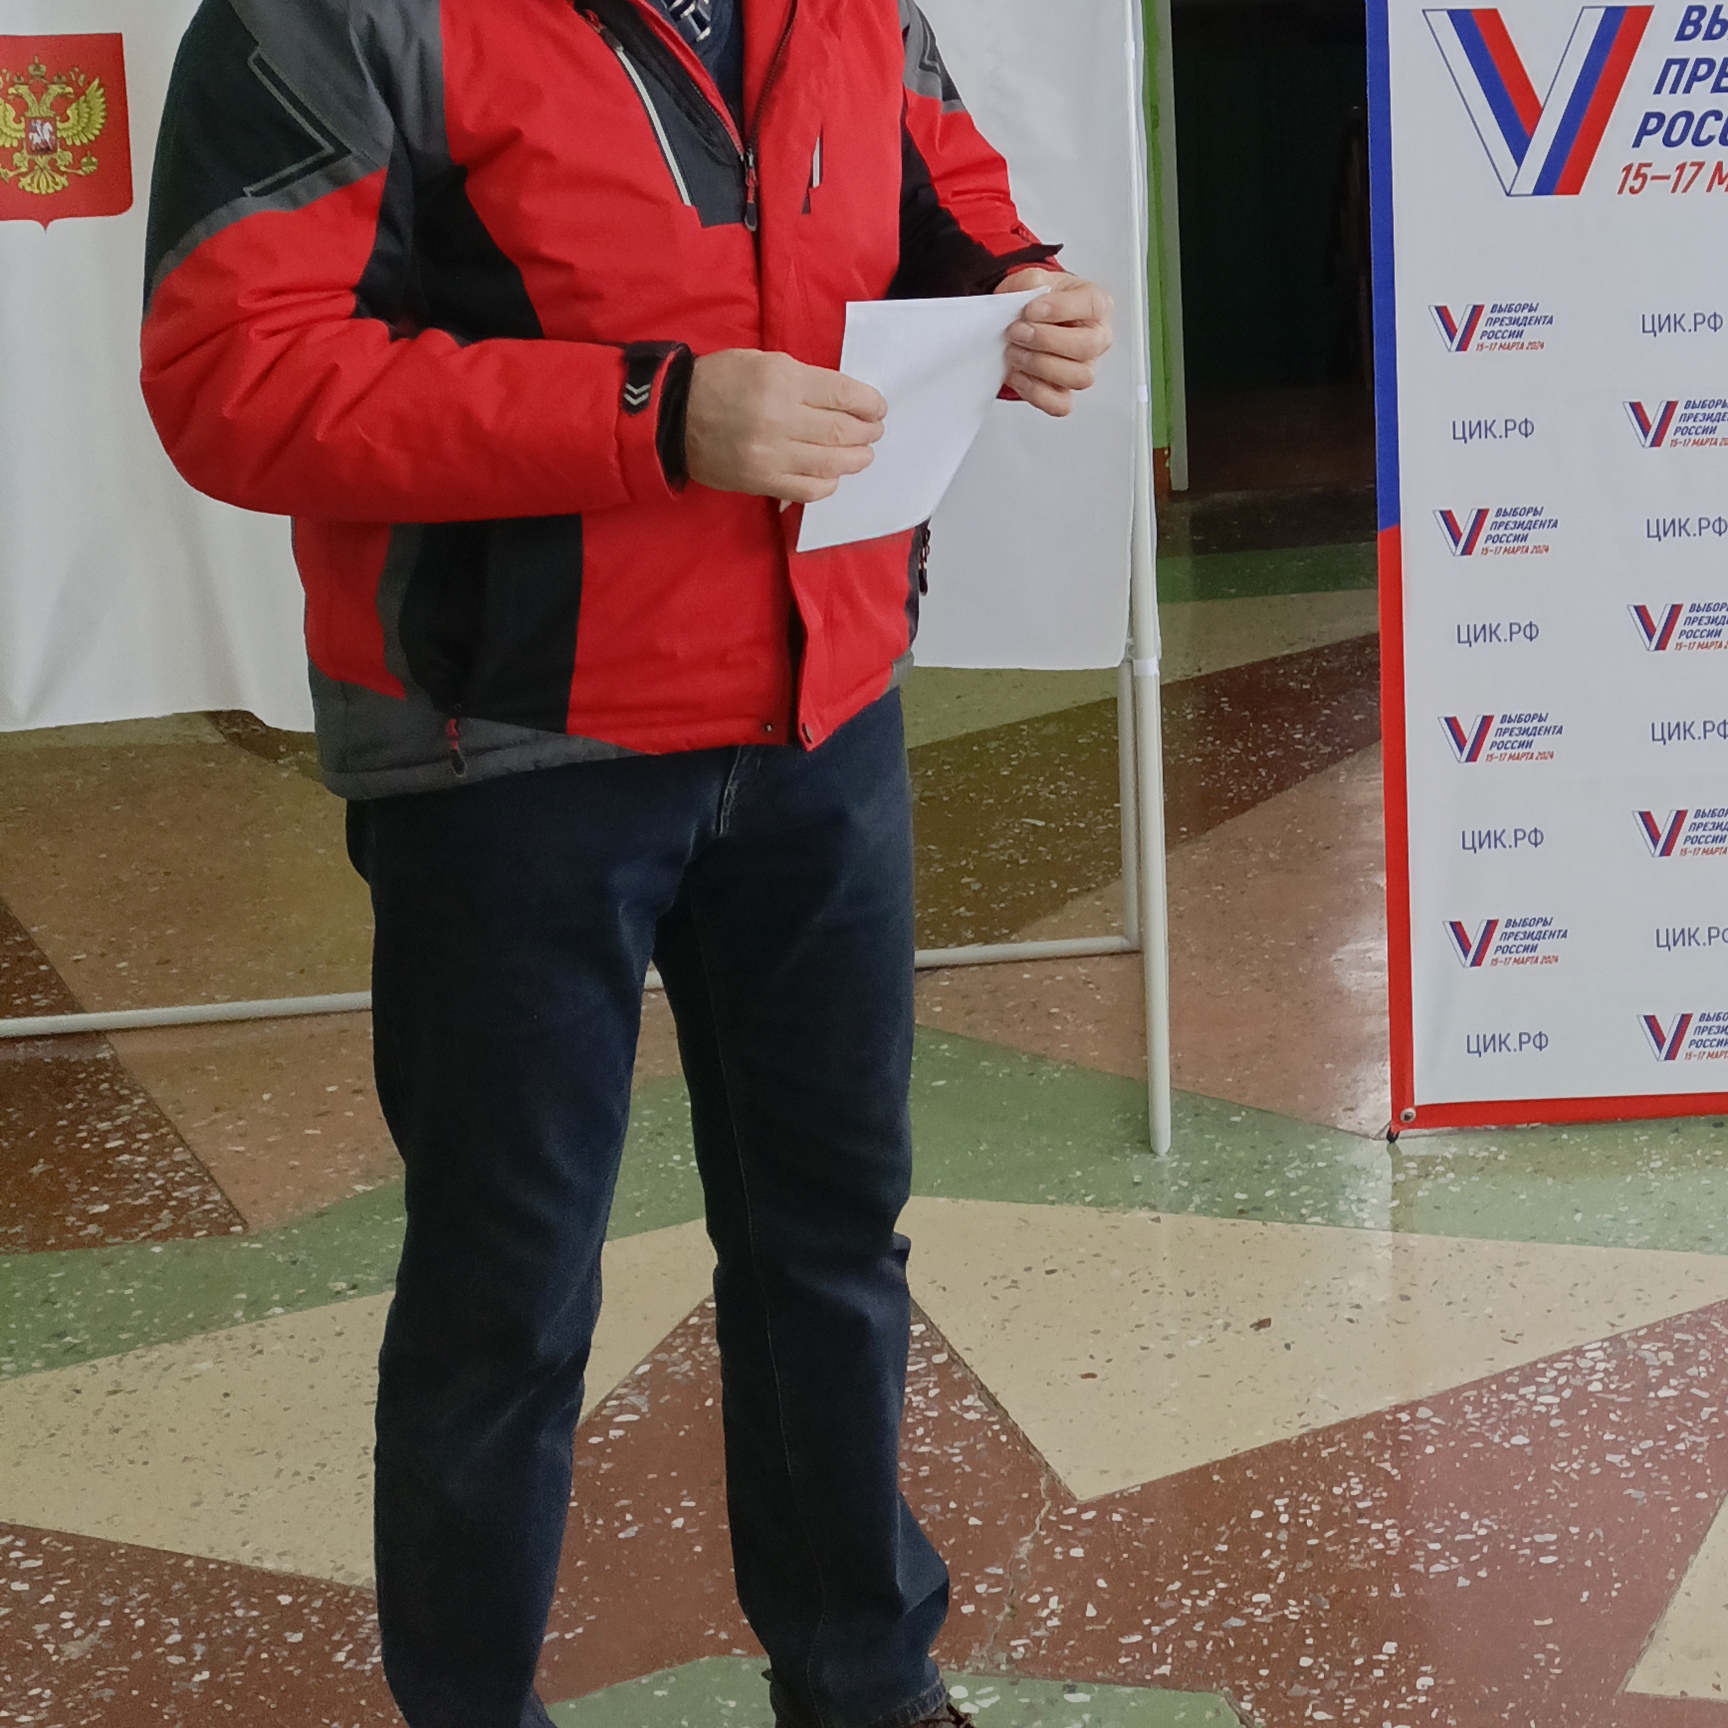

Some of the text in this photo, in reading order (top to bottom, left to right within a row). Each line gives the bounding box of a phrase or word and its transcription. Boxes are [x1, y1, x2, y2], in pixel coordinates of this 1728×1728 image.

[1489, 302, 1540, 314] ВЫБОРЫ
[1484, 314, 1554, 328] ПРЕЗИДЕНТА
[1642, 312, 1723, 337] ЦИК.РФ
[1479, 328, 1525, 341] РОССИИ
[1496, 341, 1524, 351] МАРТА
[1526, 340, 1545, 351] 2024
[1453, 418, 1534, 444] ЦИК.РФ
[1672, 425, 1718, 437] РОССИИ
[1692, 437, 1718, 447] МАРТА
[1494, 506, 1545, 518] ВЫБОРЫ
[1489, 518, 1559, 533] ПРЕЗИДЕНТА
[1647, 517, 1728, 542] ЦИК.РФ
[1483, 532, 1530, 545] РОССИИ
[1501, 545, 1529, 555] МАРТА
[1531, 544, 1550, 555] 2024
[1457, 621, 1539, 647] ЦИК.РФ
[1677, 628, 1723, 640] РОССИИ
[1697, 640, 1722, 650] МАРТА
[1499, 712, 1549, 724] ВЫБОРЫ
[1494, 724, 1564, 738] ПРЕЗИДЕНТА
[1488, 739, 1534, 751] РОССИИ
[1506, 751, 1534, 761] МАРТА
[1536, 751, 1555, 761] 2024
[1462, 828, 1544, 854] ЦИК.РФ
[1682, 834, 1728, 845] РОССИИ
[1701, 846, 1727, 856] МАРТА
[1504, 916, 1554, 928] ВЫБОРЫ
[1498, 928, 1568, 942] ПРЕЗИДЕНТА
[1493, 943, 1539, 955] РОССИИ
[1511, 955, 1539, 966] МАРТА
[1540, 955, 1559, 965] 2024
[1467, 1031, 1548, 1057] ЦИК.РФ
